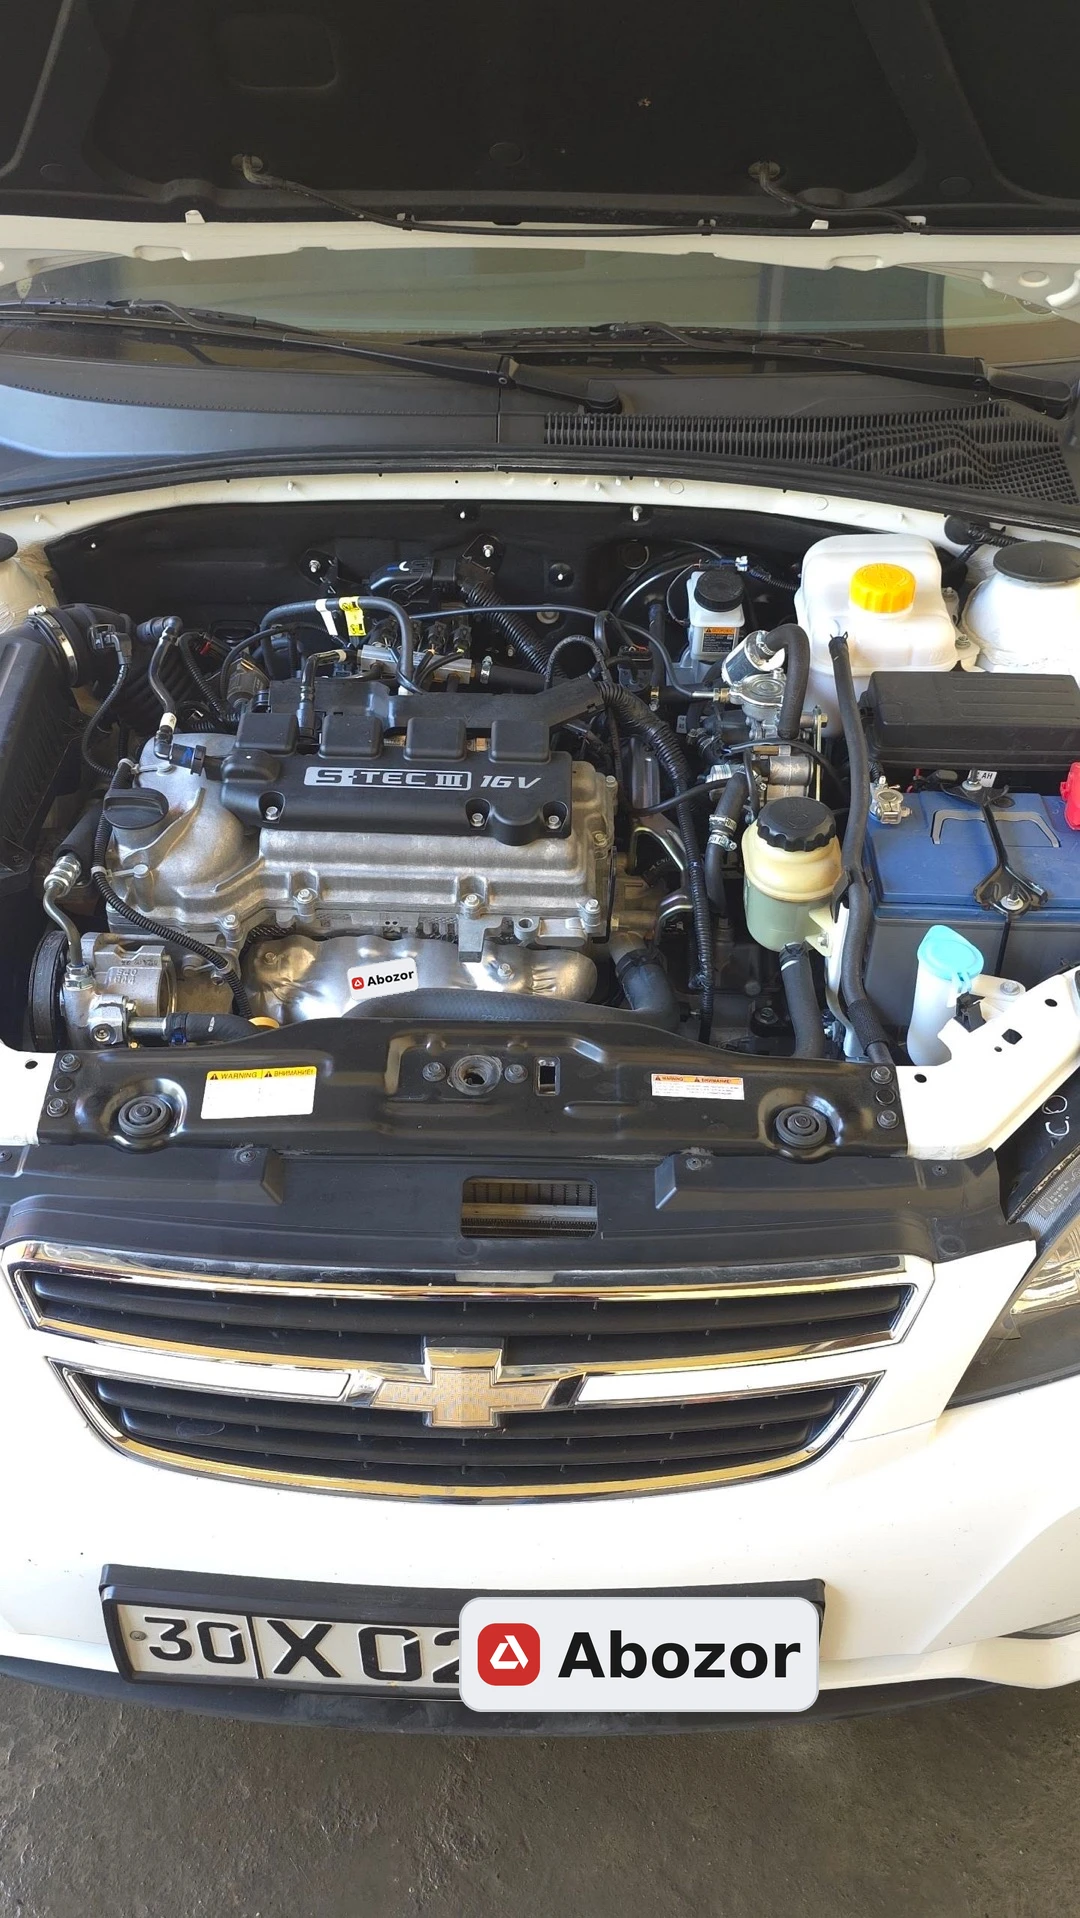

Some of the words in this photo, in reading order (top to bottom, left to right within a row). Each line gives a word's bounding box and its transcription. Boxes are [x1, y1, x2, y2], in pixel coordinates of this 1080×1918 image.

[315, 769, 427, 786] S-TEC
[434, 773, 463, 787] III
[981, 772, 993, 780] AH
[144, 1615, 248, 1664] 30
[266, 1619, 341, 1678] X
